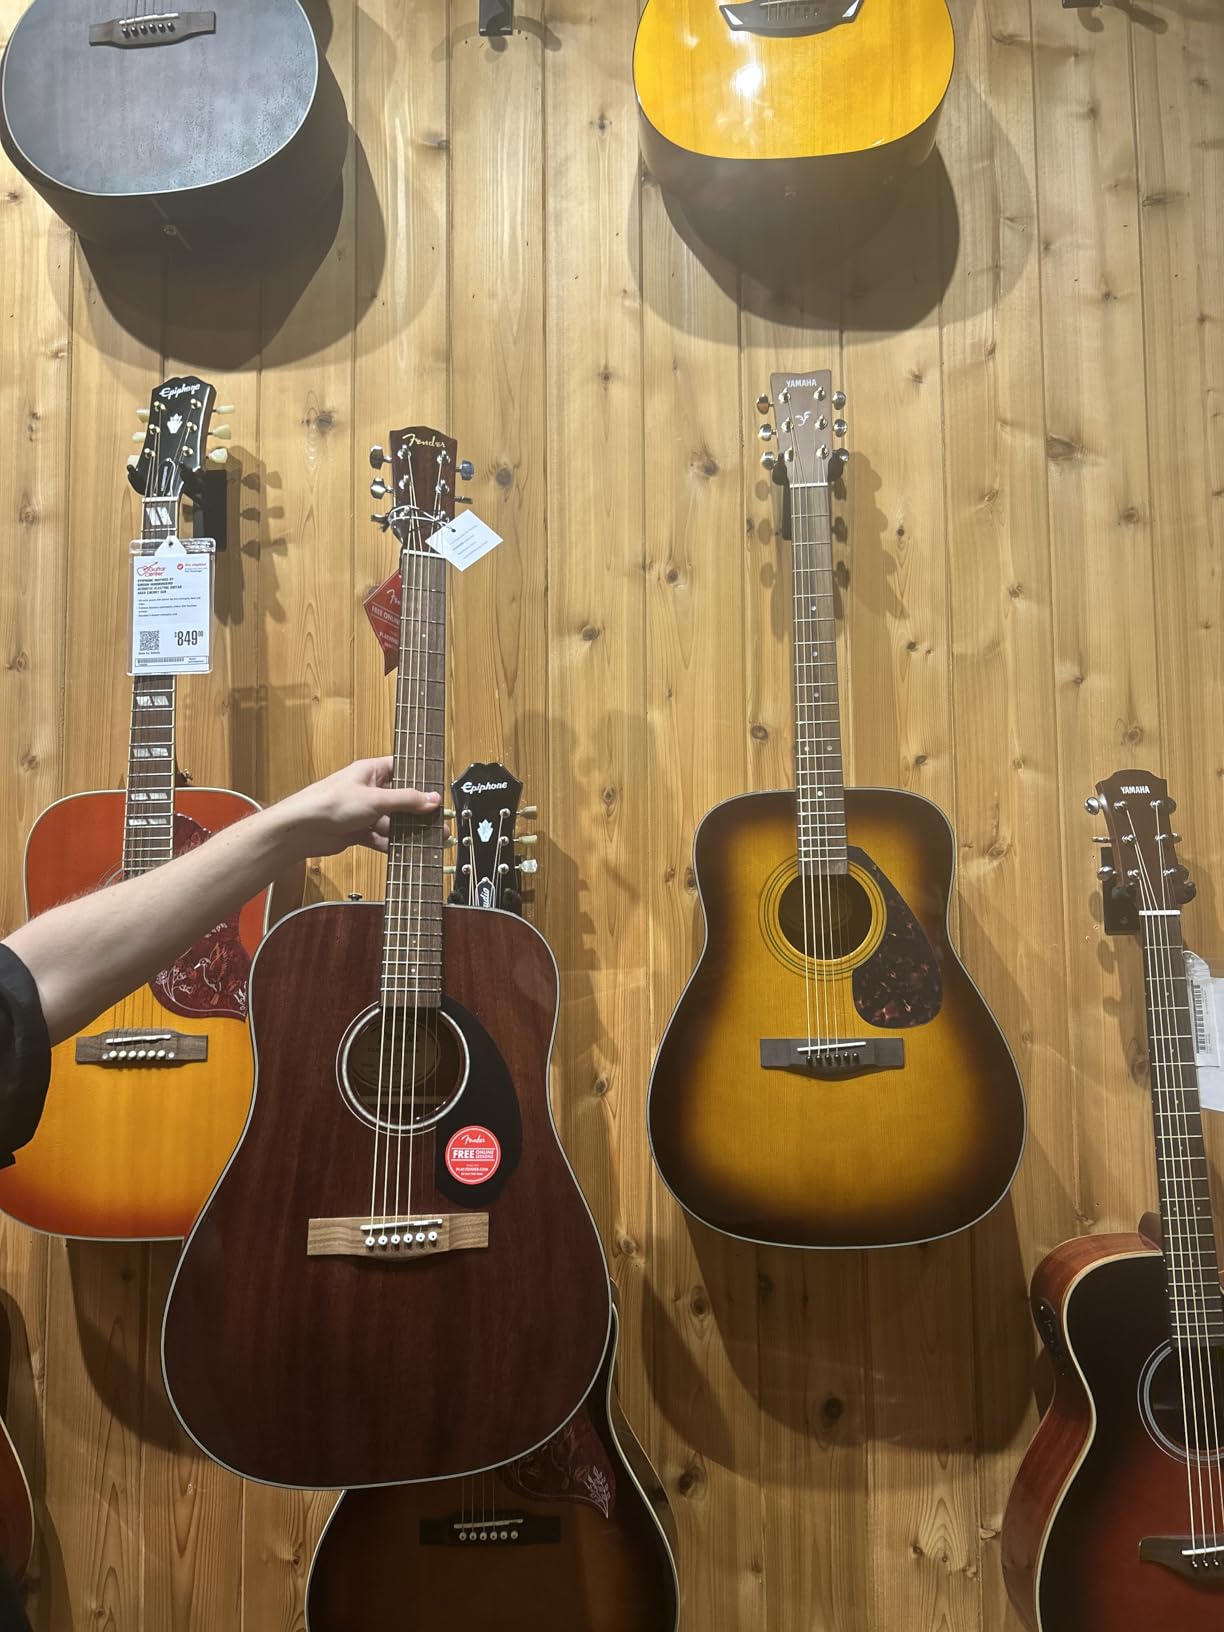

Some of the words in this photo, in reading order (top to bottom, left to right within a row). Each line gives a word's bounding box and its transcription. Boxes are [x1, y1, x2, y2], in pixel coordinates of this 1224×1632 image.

[786, 379, 817, 387] YAMAHA
[159, 384, 200, 399] Epiphone
[402, 434, 446, 447] Fender
[383, 612, 400, 625] ONLIN
[461, 782, 508, 794] Epiphone
[1120, 785, 1151, 794] YAMAHA
[480, 887, 490, 908] udio
[461, 1135, 485, 1145] Fender
[453, 1150, 475, 1159] FREE
